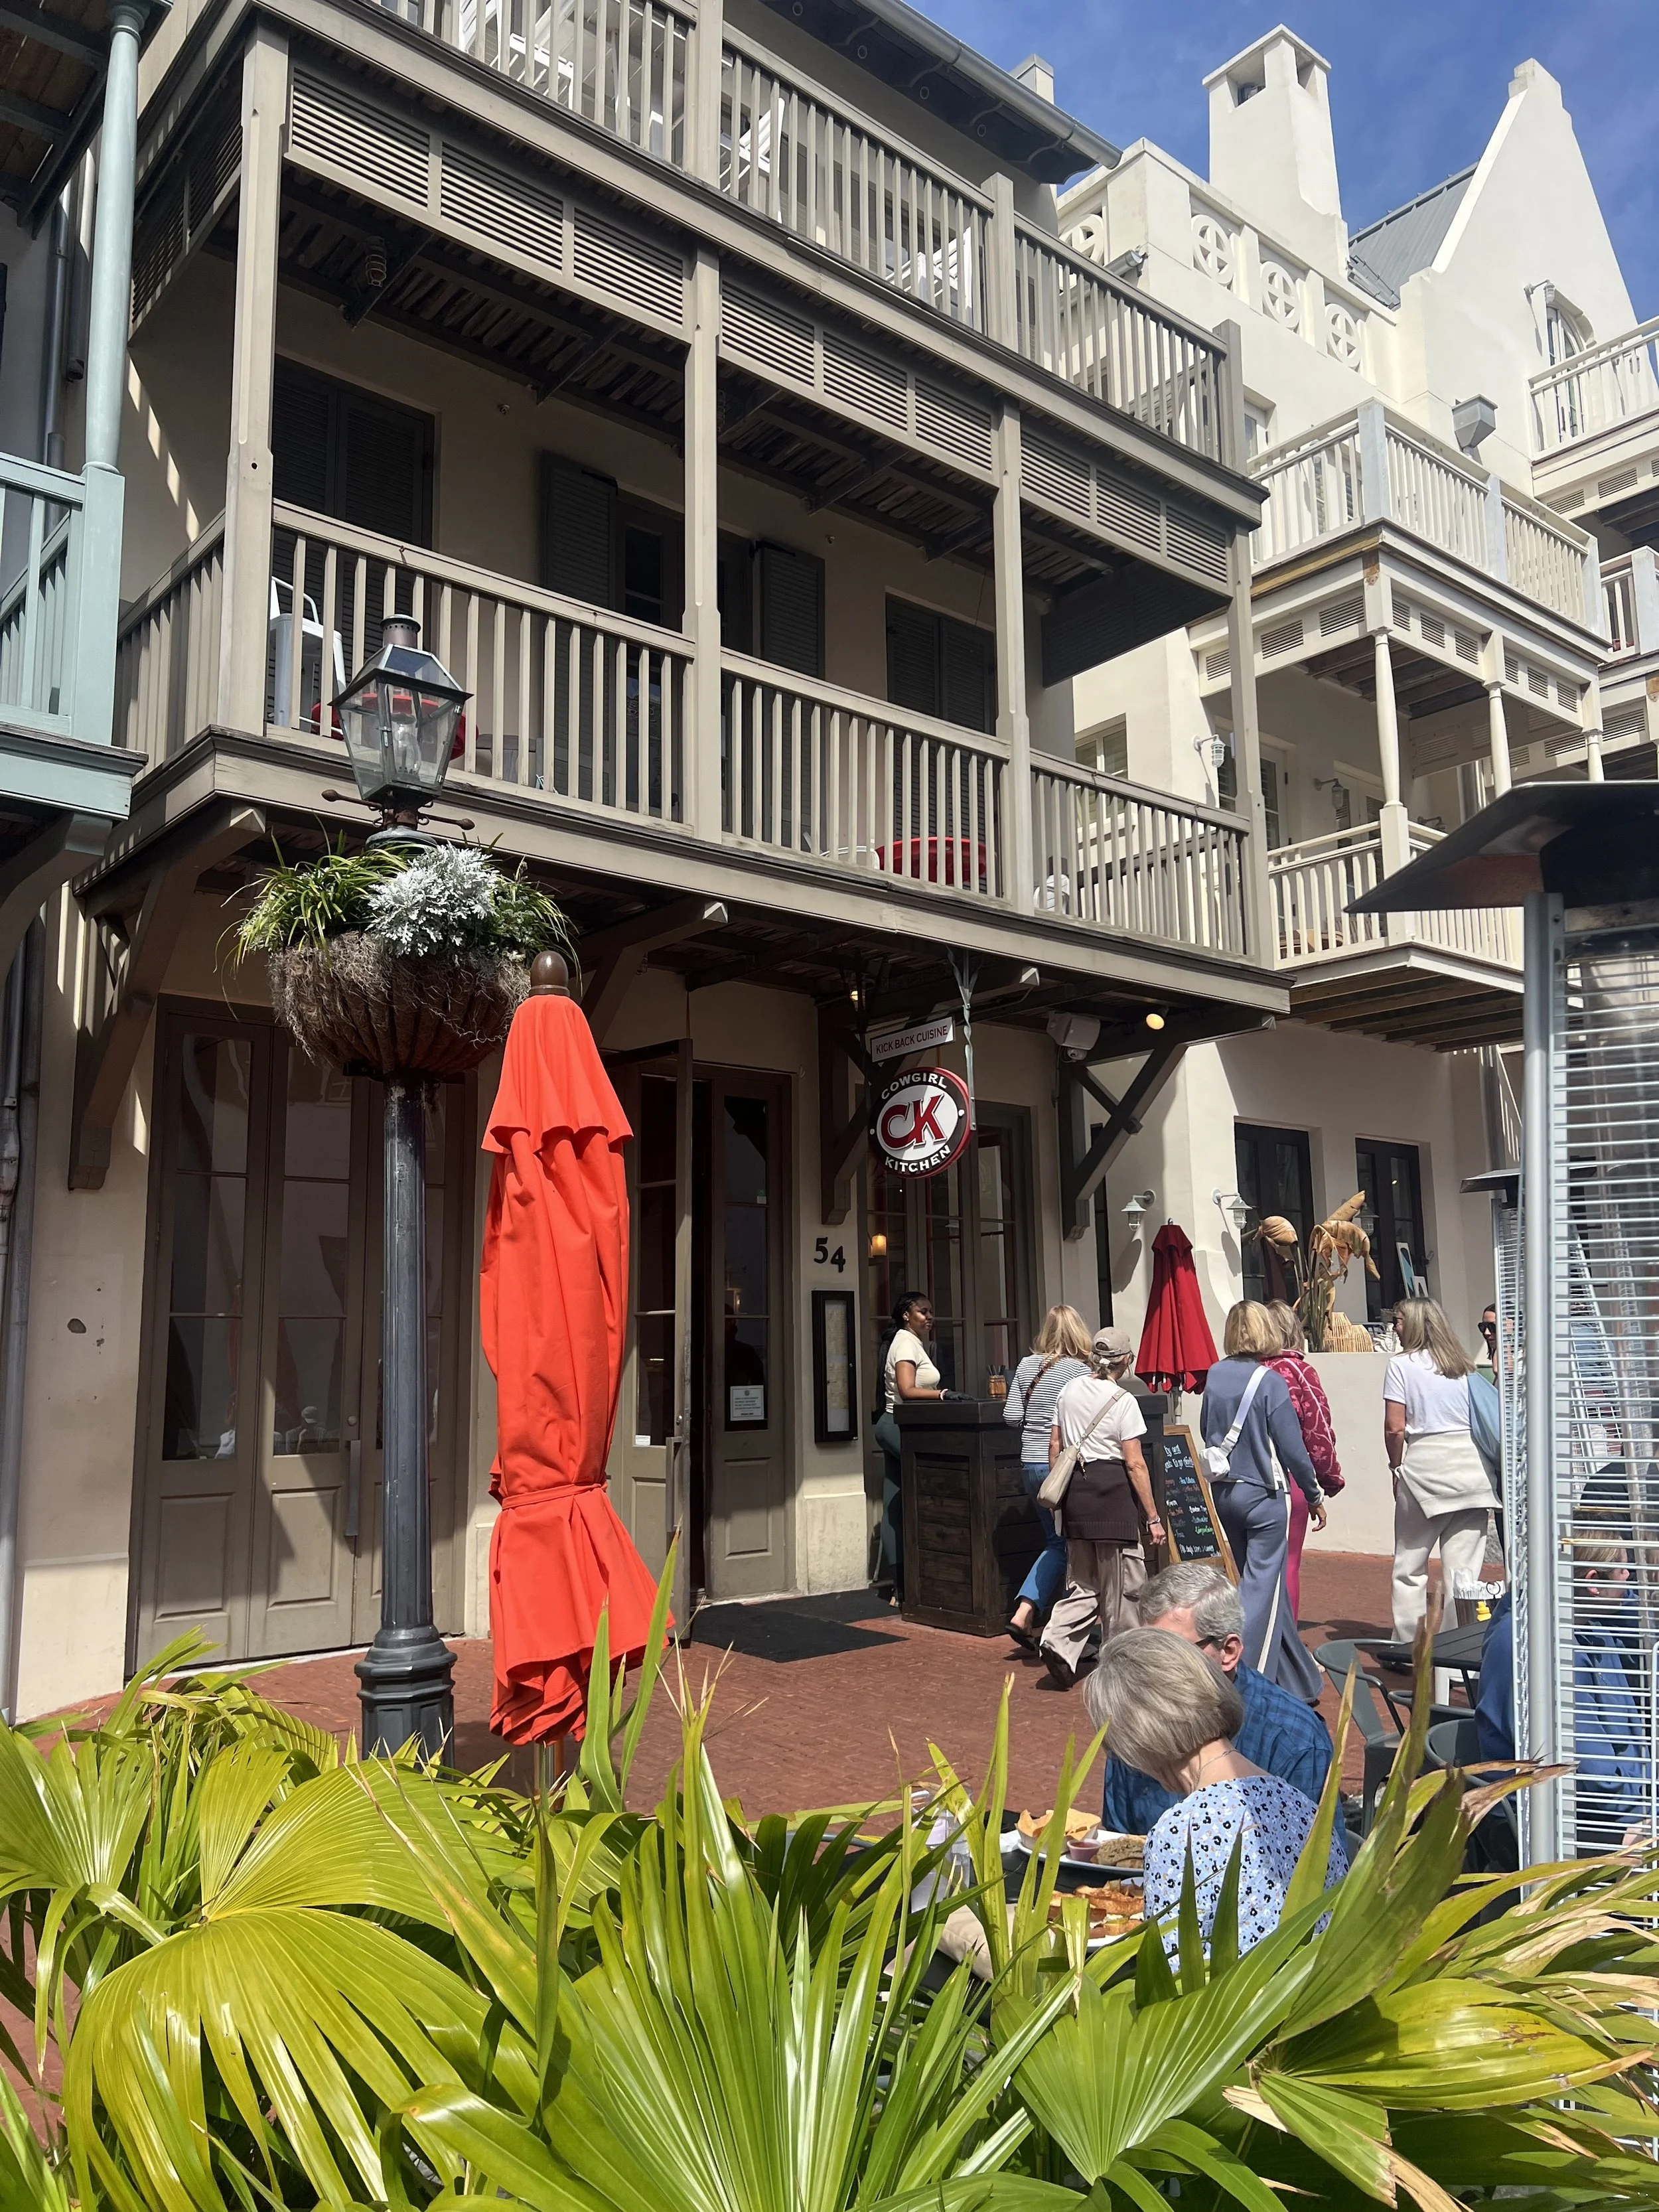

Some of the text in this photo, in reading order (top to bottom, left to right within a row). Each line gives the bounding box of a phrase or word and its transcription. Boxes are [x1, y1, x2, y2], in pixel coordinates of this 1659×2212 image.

[876, 1025, 948, 1054] KICK BACK CUISINE
[881, 1072, 947, 1100] COWGIRL
[881, 1093, 947, 1149] CK
[885, 1144, 951, 1173] KITCHEN
[814, 1236, 846, 1273] 54
